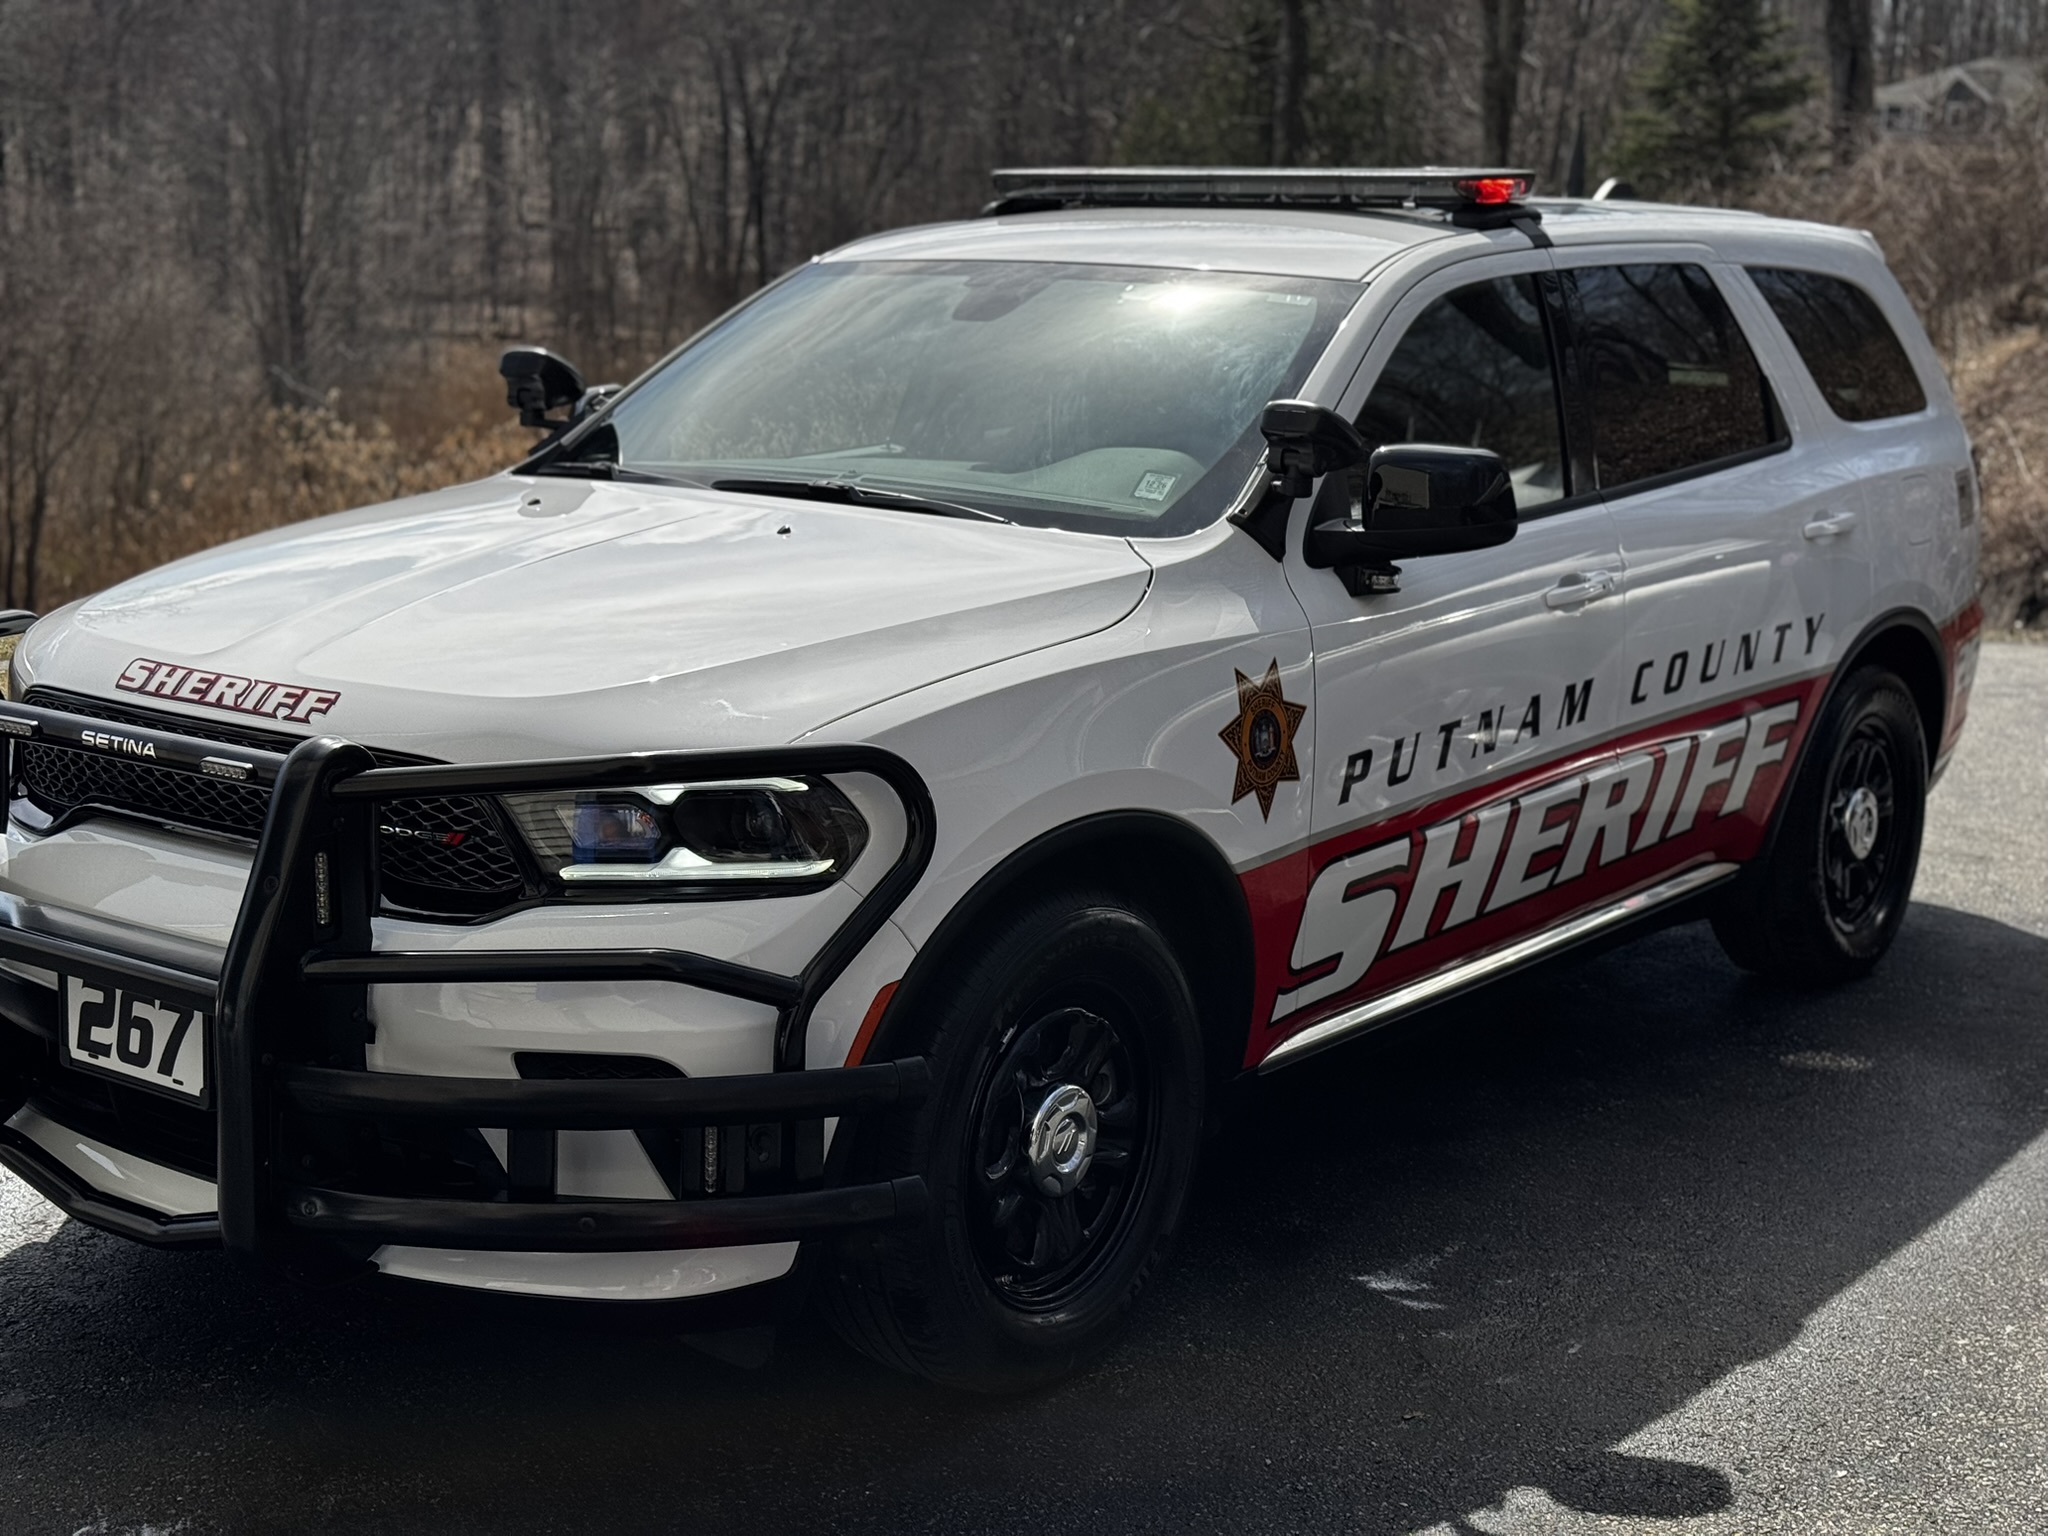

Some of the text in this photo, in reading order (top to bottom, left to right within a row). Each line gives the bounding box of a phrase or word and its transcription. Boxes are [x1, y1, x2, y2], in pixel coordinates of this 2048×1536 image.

[115, 658, 341, 724] SHERIFF
[1250, 698, 1276, 715] SHERIFF
[1338, 613, 1825, 805] PUTNAM COUNTY
[81, 730, 157, 759] SETINA
[1247, 750, 1285, 781] PUTNAM COUNTY
[379, 825, 451, 842] ODGE
[1268, 699, 1800, 1027] SHERIFF
[77, 981, 195, 1077] 267
